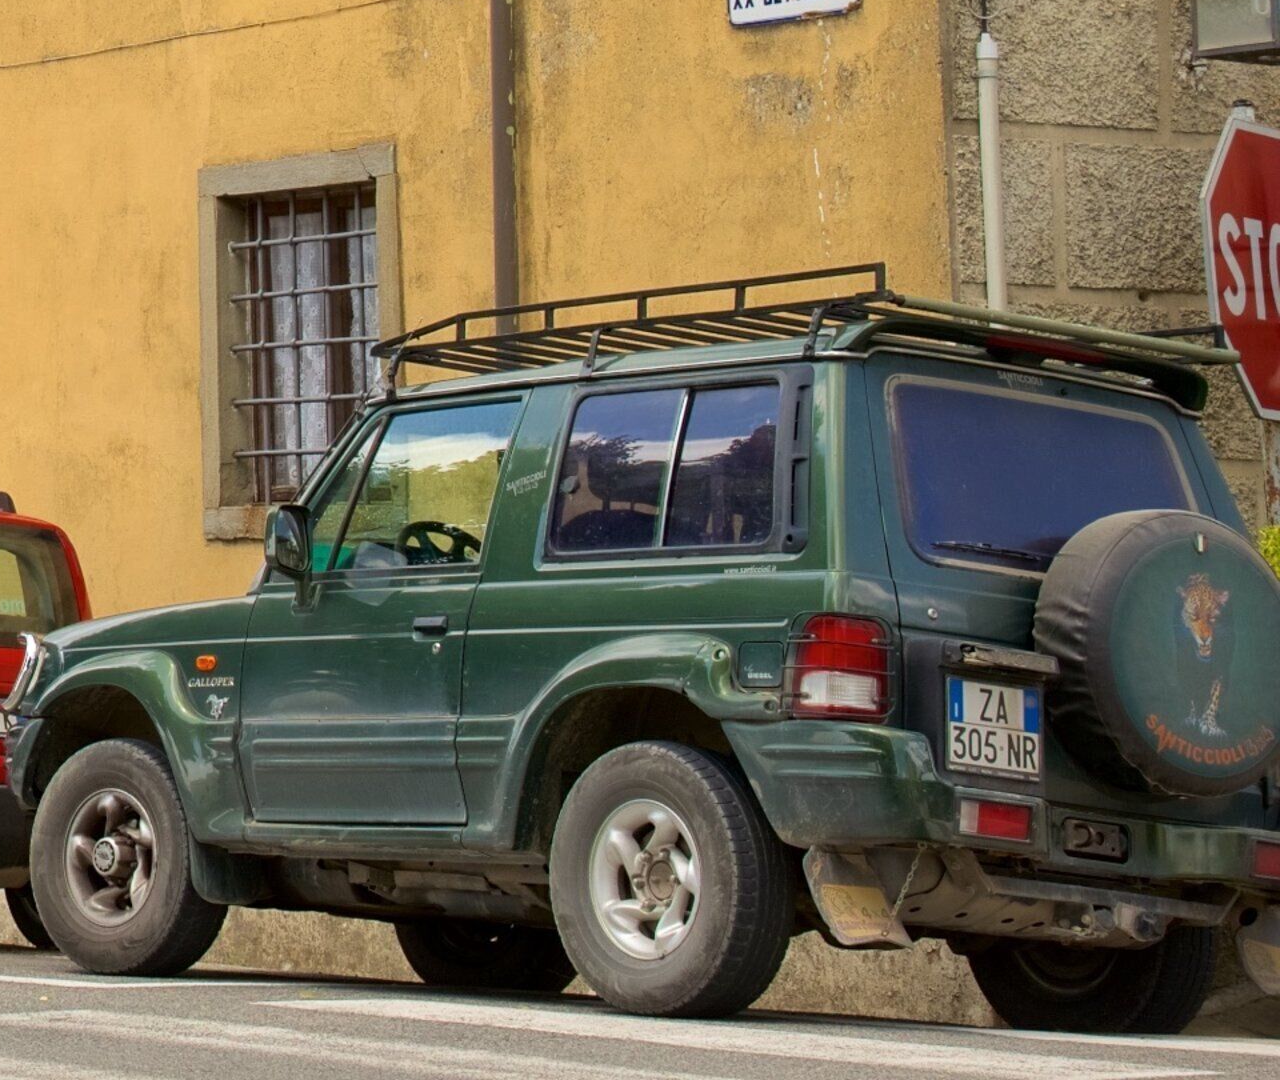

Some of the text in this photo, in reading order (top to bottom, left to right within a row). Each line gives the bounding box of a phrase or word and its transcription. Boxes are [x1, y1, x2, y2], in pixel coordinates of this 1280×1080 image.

[980, 688, 1008, 724] ZA
[953, 726, 1036, 770] 305 NR
